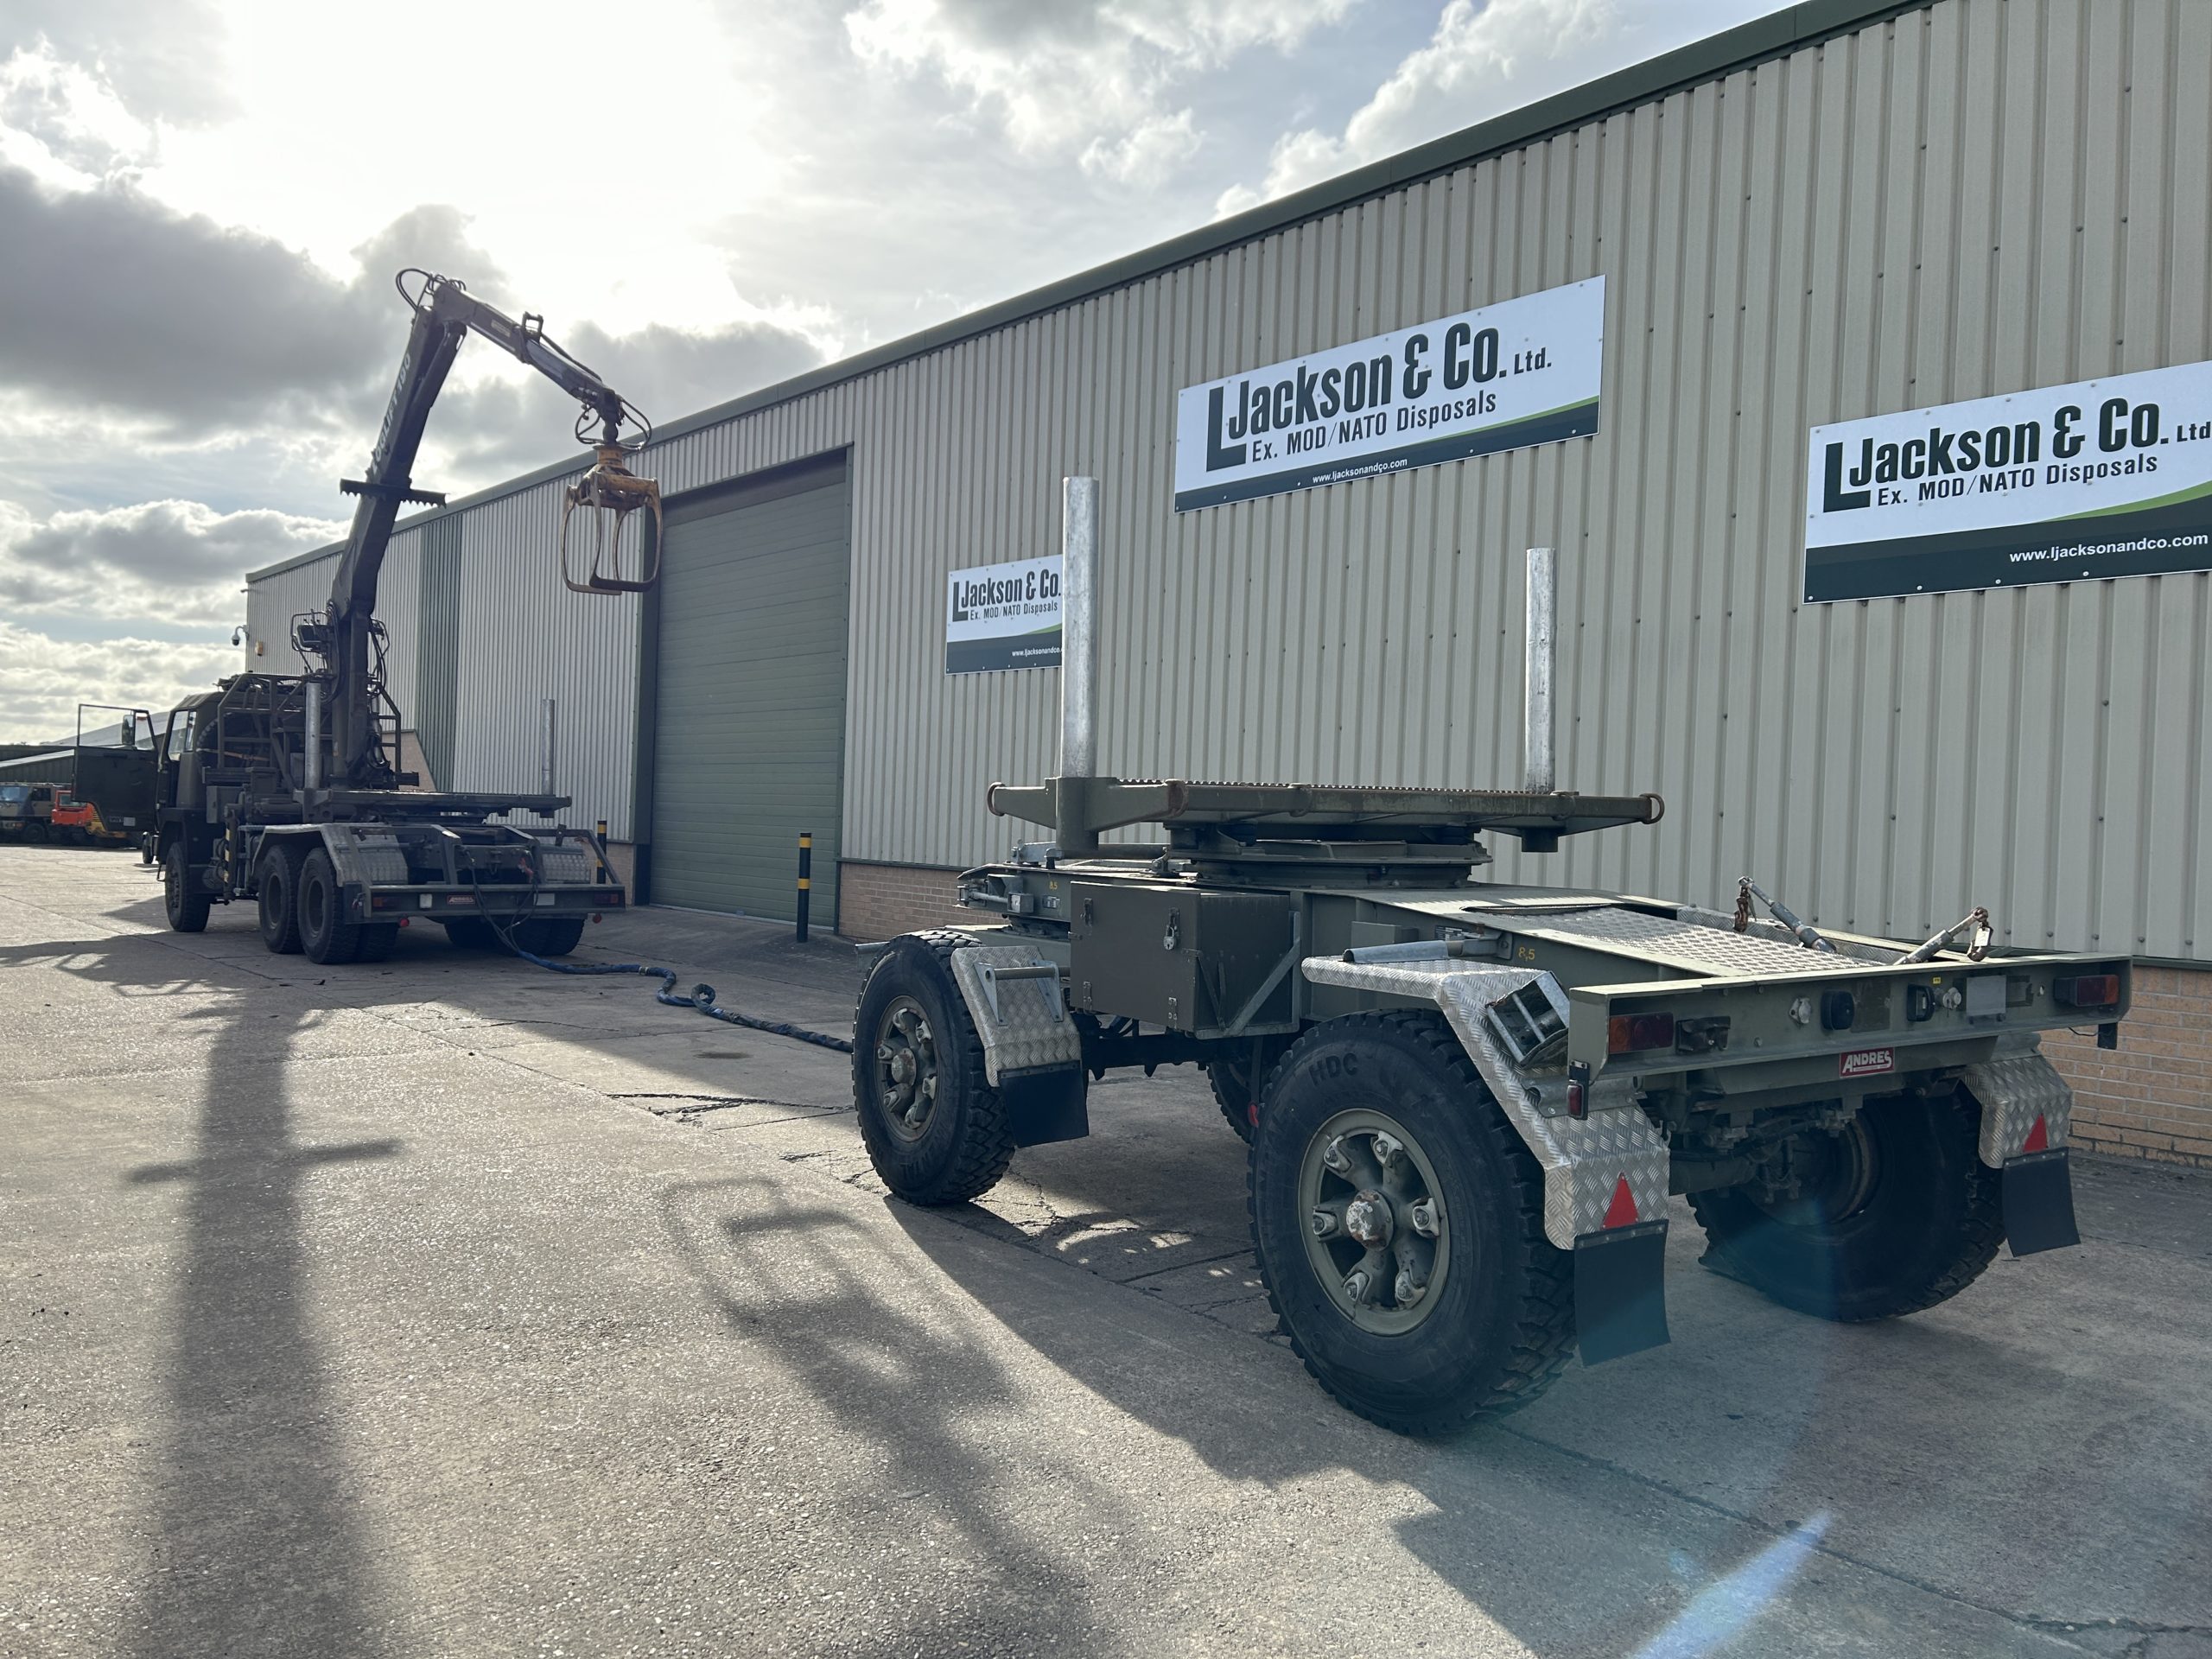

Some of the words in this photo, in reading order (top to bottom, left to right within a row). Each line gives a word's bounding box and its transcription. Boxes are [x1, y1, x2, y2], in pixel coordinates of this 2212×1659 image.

[1402, 333, 1432, 399] &
[1443, 321, 1507, 390] Co.
[1513, 346, 1553, 374] Ltd.
[1252, 440, 1278, 463] Ex.
[1287, 410, 1388, 457] MOD/NATO
[1397, 391, 1497, 432] Disposals
[2052, 404, 2086, 459] &
[2098, 397, 2169, 453] Co.
[2177, 421, 2211, 442] Ltd
[1313, 458, 1408, 484] www.ljacksonandco.com
[1878, 487, 1908, 506] Ex.
[1917, 467, 2036, 502] MOD/NATO
[2046, 453, 2158, 485] Disposals
[2009, 532, 2209, 564] www.ljacksonandco.com
[1026, 570, 1036, 601] &
[1039, 568, 1061, 599] Co.
[970, 609, 981, 620] Ex.
[983, 604, 1020, 620] MOD/NATO
[1023, 600, 1058, 615] Disposals
[1517, 946, 1536, 962] 8,5
[1308, 1052, 1359, 1088] HDC
[1841, 1050, 1892, 1074] ANDRES
